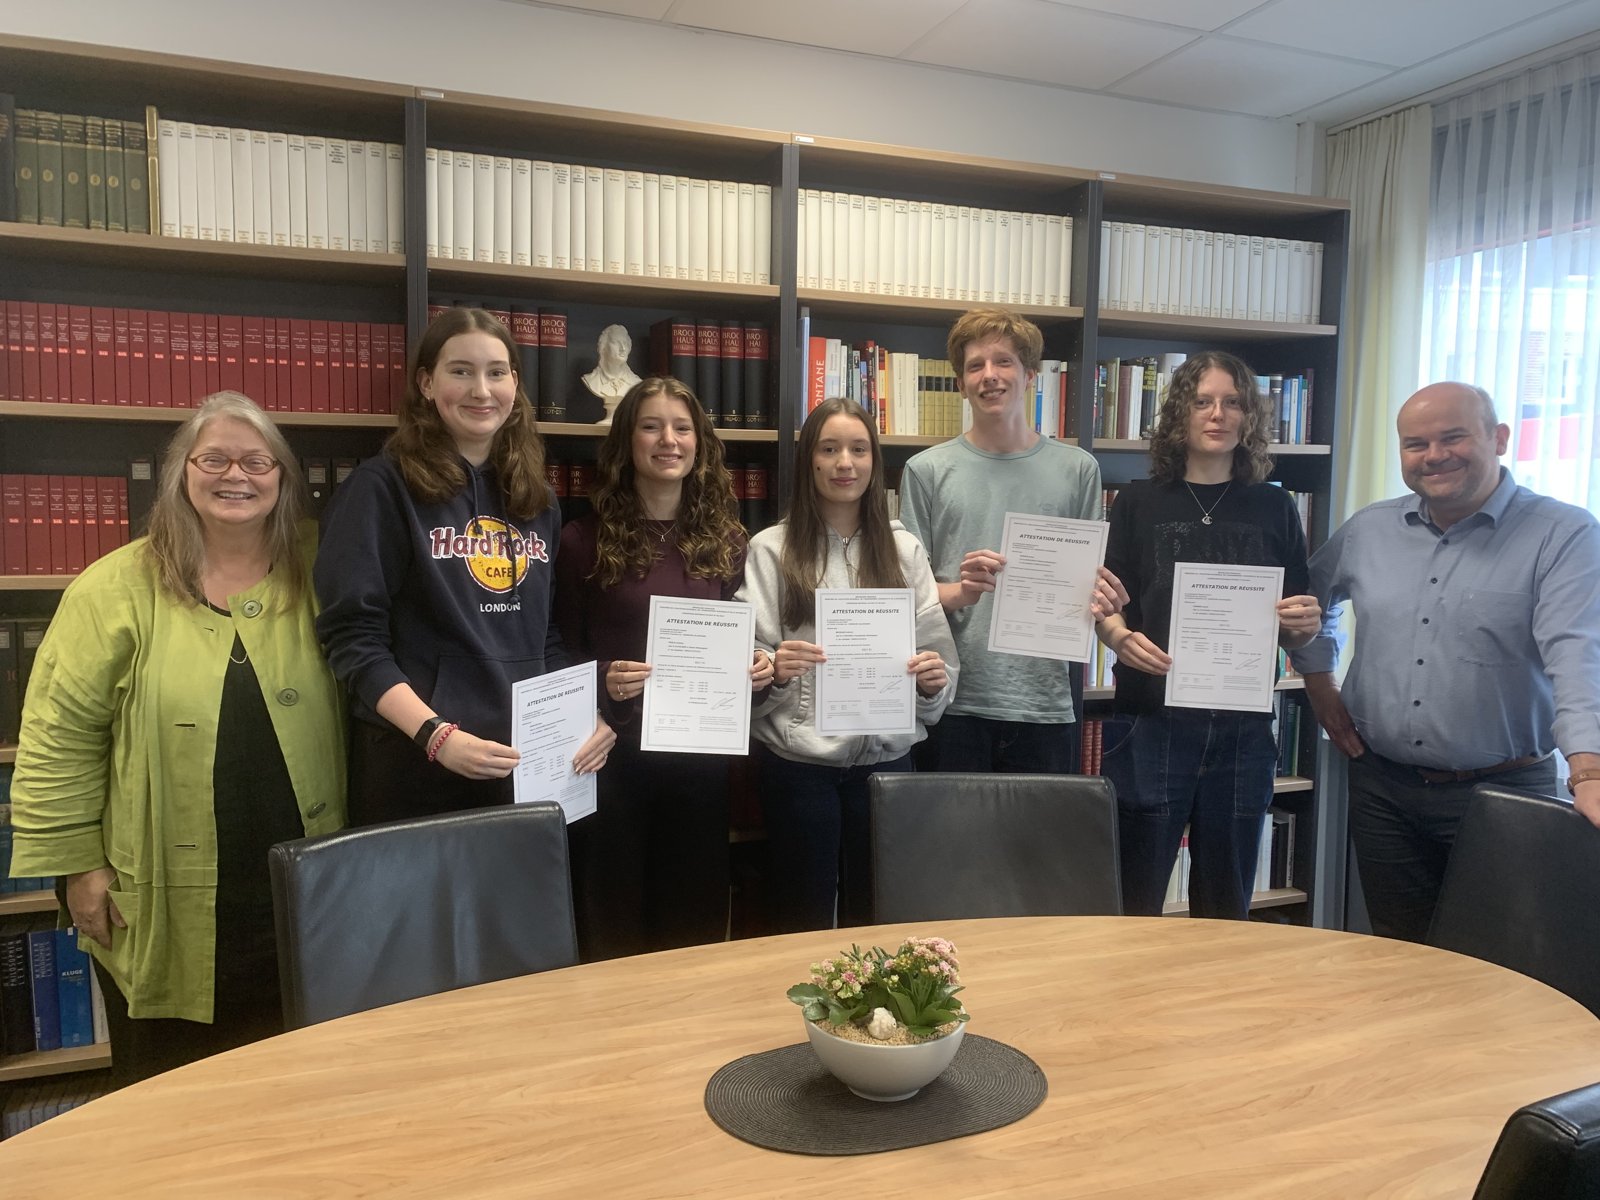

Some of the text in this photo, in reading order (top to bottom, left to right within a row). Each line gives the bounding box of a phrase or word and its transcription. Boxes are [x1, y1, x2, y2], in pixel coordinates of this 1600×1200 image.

[514, 318, 537, 326] BROCK
[541, 319, 566, 328] BROCK
[544, 327, 564, 335] HAUS
[815, 360, 825, 407] ONTANE
[1019, 533, 1055, 542] ATTESTATION
[430, 526, 550, 564] Hard Rock
[485, 566, 513, 578] CAFE
[479, 602, 521, 613] LONDON
[666, 618, 703, 626] ATTESTATION
[527, 694, 557, 707] ATTESTATION
[62, 969, 83, 977] KLUGE
